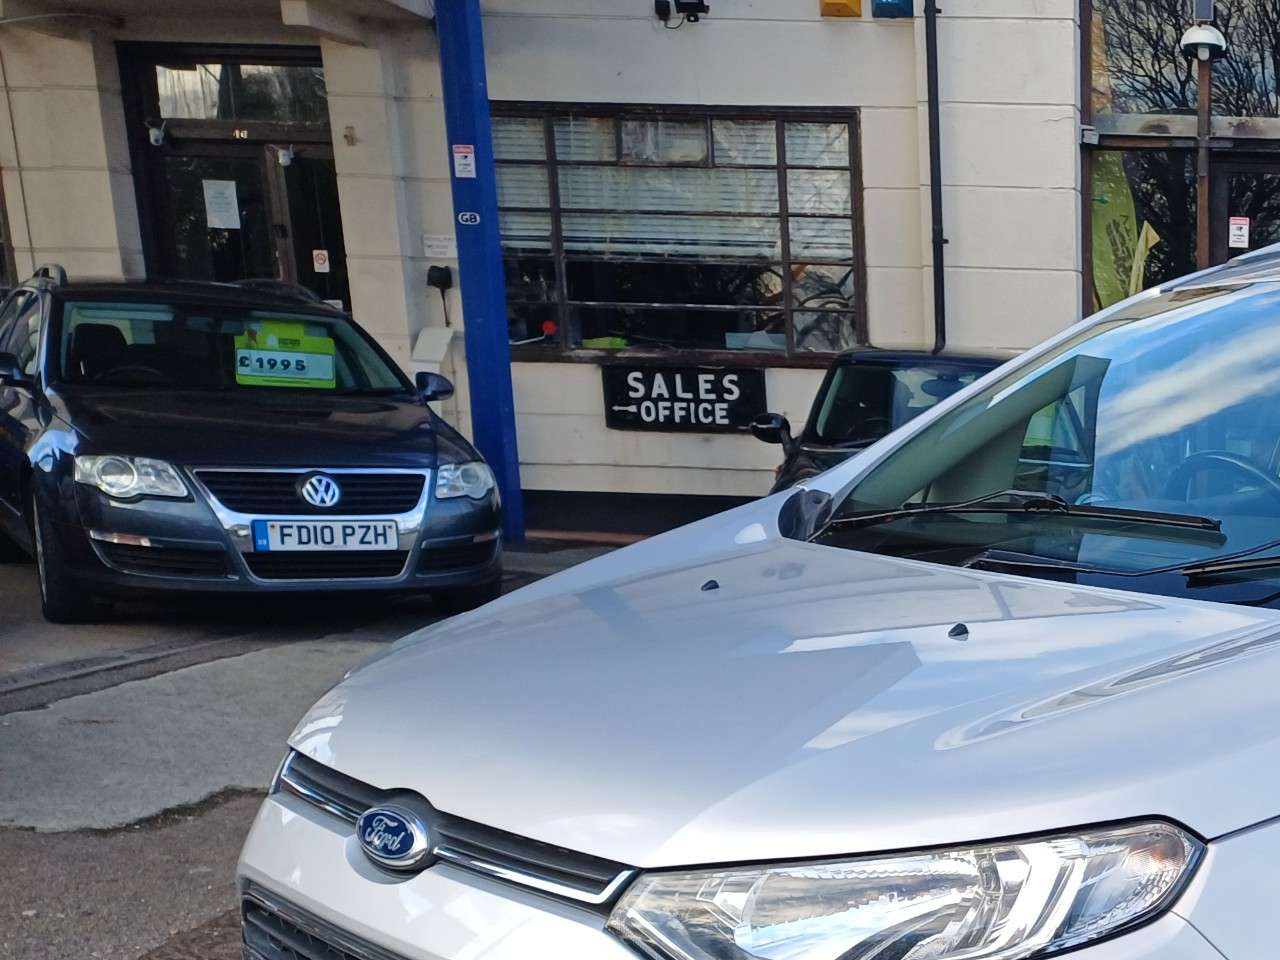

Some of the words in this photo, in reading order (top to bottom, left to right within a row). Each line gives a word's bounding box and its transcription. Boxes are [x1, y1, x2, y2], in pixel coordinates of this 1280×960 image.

[460, 213, 477, 223] GB
[627, 372, 740, 400] SALES
[640, 401, 729, 424] OFFICE
[279, 525, 334, 545] FD10
[342, 525, 388, 545] PZH
[365, 815, 406, 851] Ford
